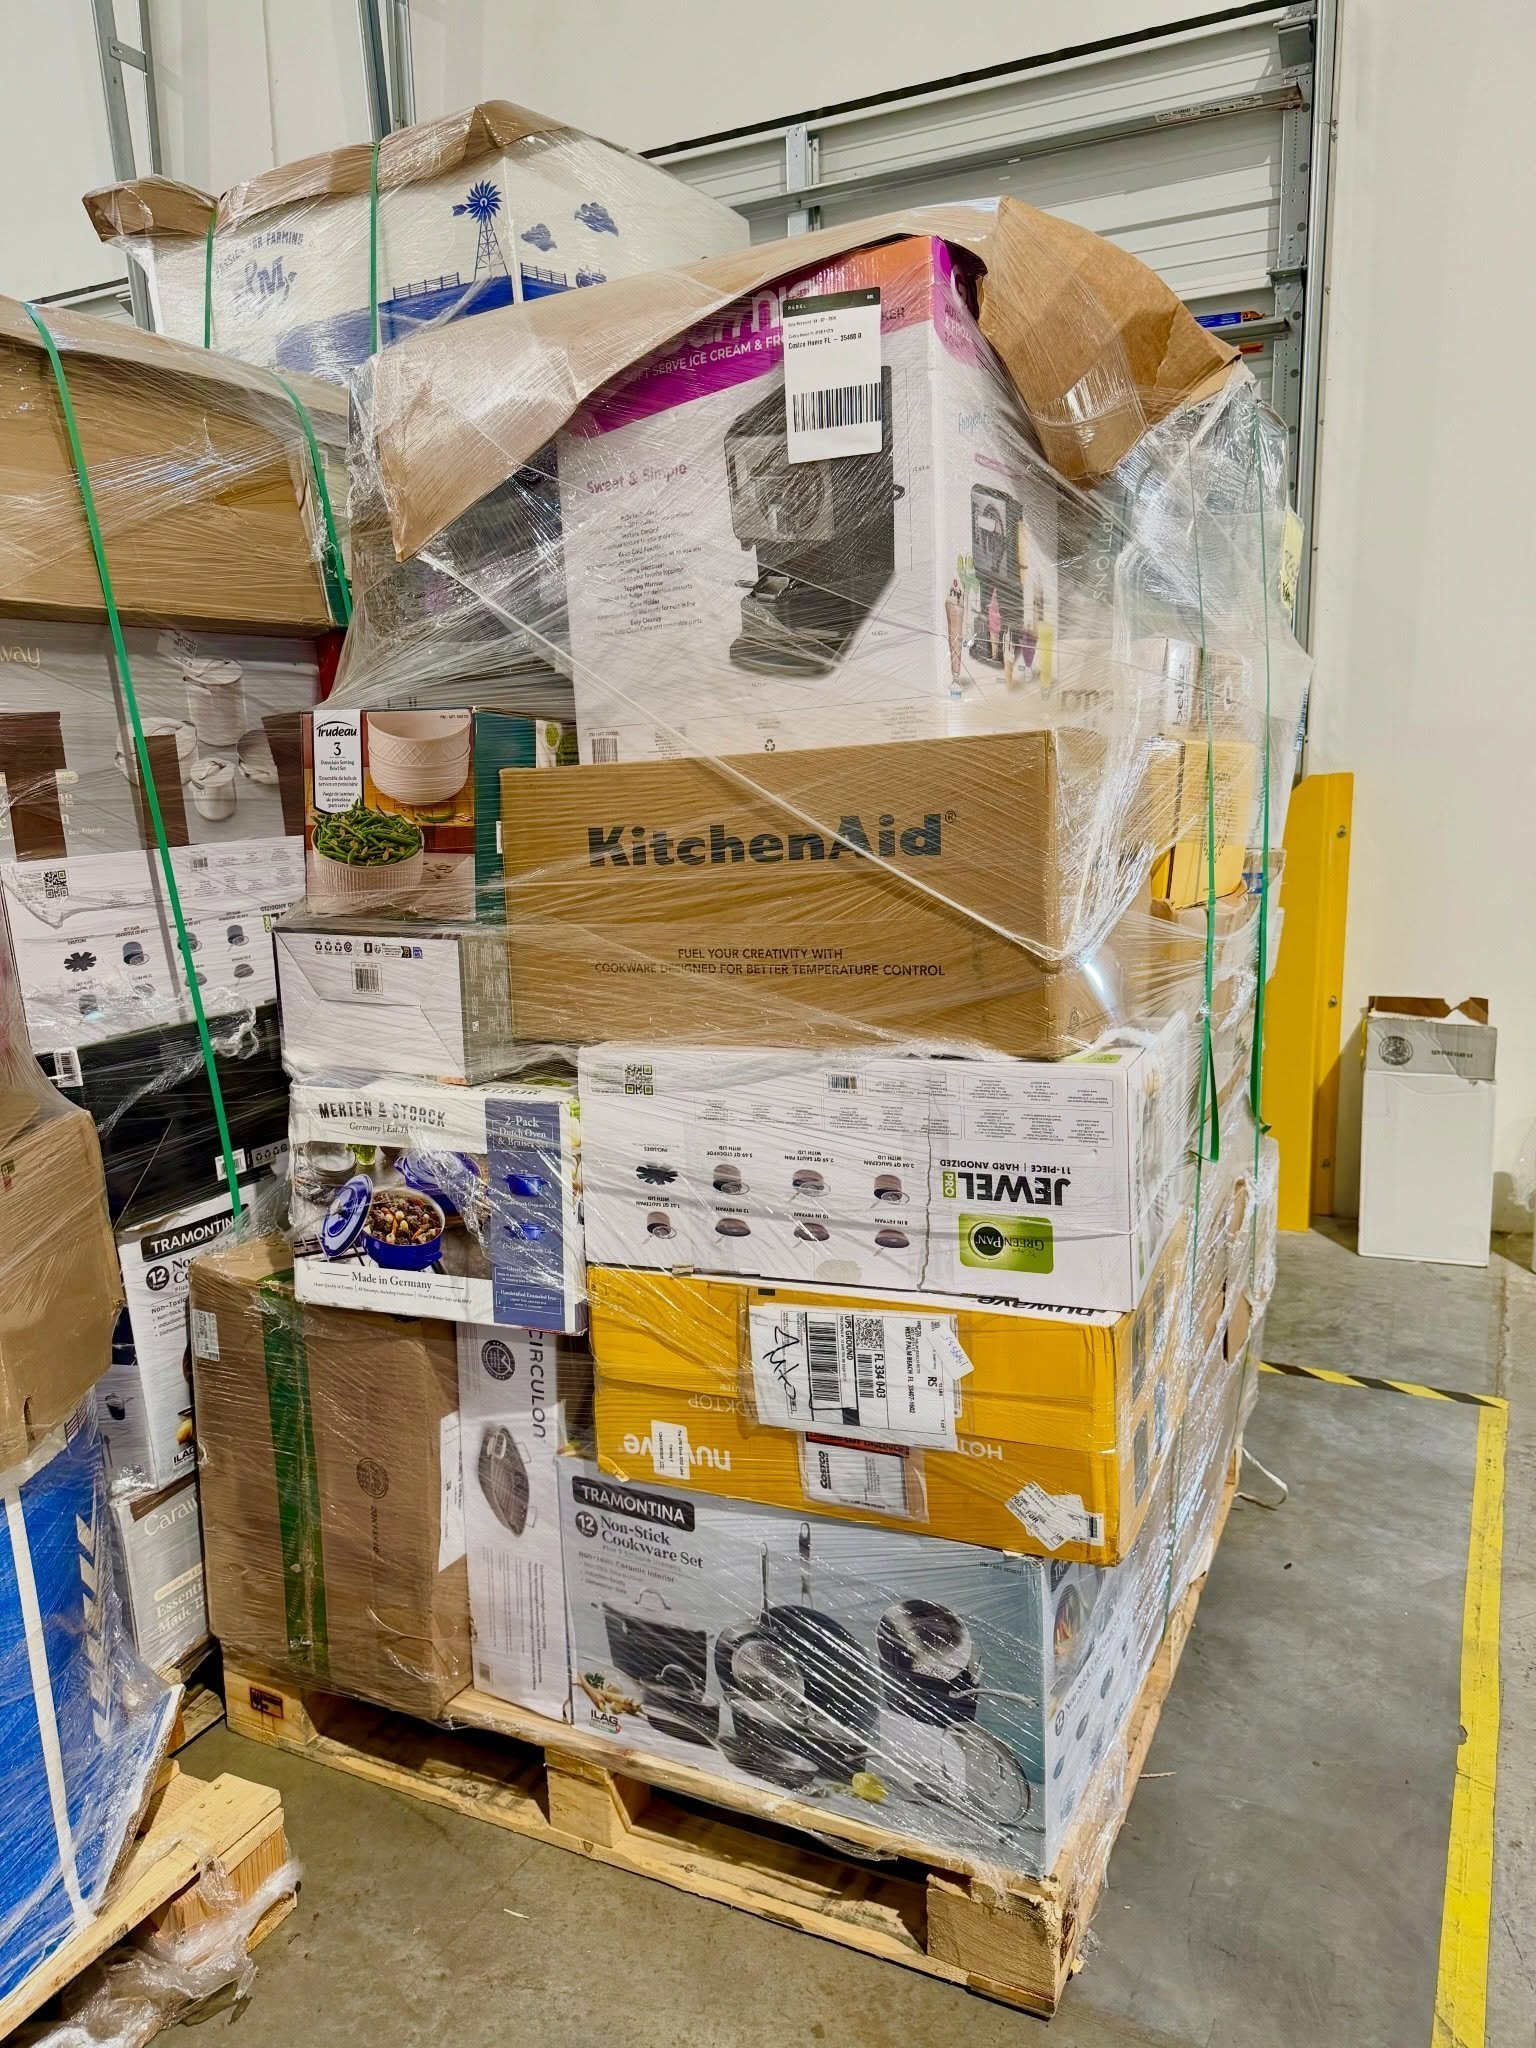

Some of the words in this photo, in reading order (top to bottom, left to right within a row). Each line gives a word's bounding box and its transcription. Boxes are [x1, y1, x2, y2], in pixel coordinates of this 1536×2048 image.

[880, 306, 906, 321] KER
[788, 340, 806, 350] Costco
[807, 338, 823, 347] Home
[653, 358, 686, 377] SERVE
[689, 351, 708, 367] ICE
[710, 341, 751, 362] CREAM
[754, 339, 763, 351] &
[766, 333, 783, 349] FR
[586, 475, 624, 494] Sweet
[628, 471, 638, 486] &
[642, 463, 688, 482] Simple
[0, 644, 42, 669] way
[316, 721, 359, 738] Trudeau
[333, 741, 342, 756] 3
[588, 813, 942, 868] KitchenAid
[678, 948, 704, 959] FUEL
[708, 948, 740, 959] YOUR
[742, 948, 808, 960] CREATIVITY
[811, 948, 843, 960] WITH
[595, 962, 657, 974] COOKWARE
[660, 963, 717, 974] DESIGNED
[720, 963, 743, 975] FOR
[746, 963, 790, 975] BETTER
[792, 964, 880, 976] TEMPERATURE
[882, 963, 946, 977] CONTROL
[318, 1101, 373, 1119] MERTEN
[377, 1101, 388, 1118] &
[392, 1103, 446, 1128] STORCK
[505, 1115, 539, 1128] 2-Pack
[349, 1122, 382, 1133] Germany
[499, 1126, 524, 1137] Dutch
[525, 1127, 546, 1139] Oven
[863, 1159, 894, 1168] SAUCEPAN
[939, 1159, 990, 1170] ANODIZED
[993, 1162, 1020, 1171] HARD
[1031, 1164, 1071, 1175] 11-PIECE
[944, 1172, 955, 1198] PRO
[957, 1171, 1072, 1206] JEWEL
[150, 1215, 235, 1255] TRAMONTIN
[147, 1267, 168, 1285] 12
[351, 1271, 378, 1286] Made
[378, 1274, 388, 1285] in
[389, 1276, 433, 1292] Germany
[174, 1284, 189, 1293] Plus
[151, 1297, 187, 1315] Non-Toxic
[844, 1315, 853, 1329] UPS
[904, 1326, 912, 1341] WEST
[845, 1330, 854, 1361] GROUND
[905, 1341, 913, 1356] PALM
[874, 1353, 884, 1363] FL
[906, 1356, 914, 1375] BEACH
[874, 1364, 885, 1379] 334
[528, 1330, 547, 1439] CIRCULON
[927, 1376, 938, 1388] RS
[688, 1393, 754, 1417] OKTOP
[819, 1450, 829, 1490] COSTCO
[581, 1484, 686, 1524] TRAMONTINA
[143, 1496, 198, 1537] Cara
[577, 1514, 595, 1531] 12
[600, 1515, 672, 1546] Non-Stick
[602, 1530, 678, 1562] Cookware
[680, 1551, 704, 1569] Set
[615, 1560, 646, 1576] Ceramic
[647, 1570, 675, 1583] Interior
[156, 1578, 203, 1619] Essenti
[159, 1604, 192, 1634] Made
[590, 1708, 619, 1727] ILAG
